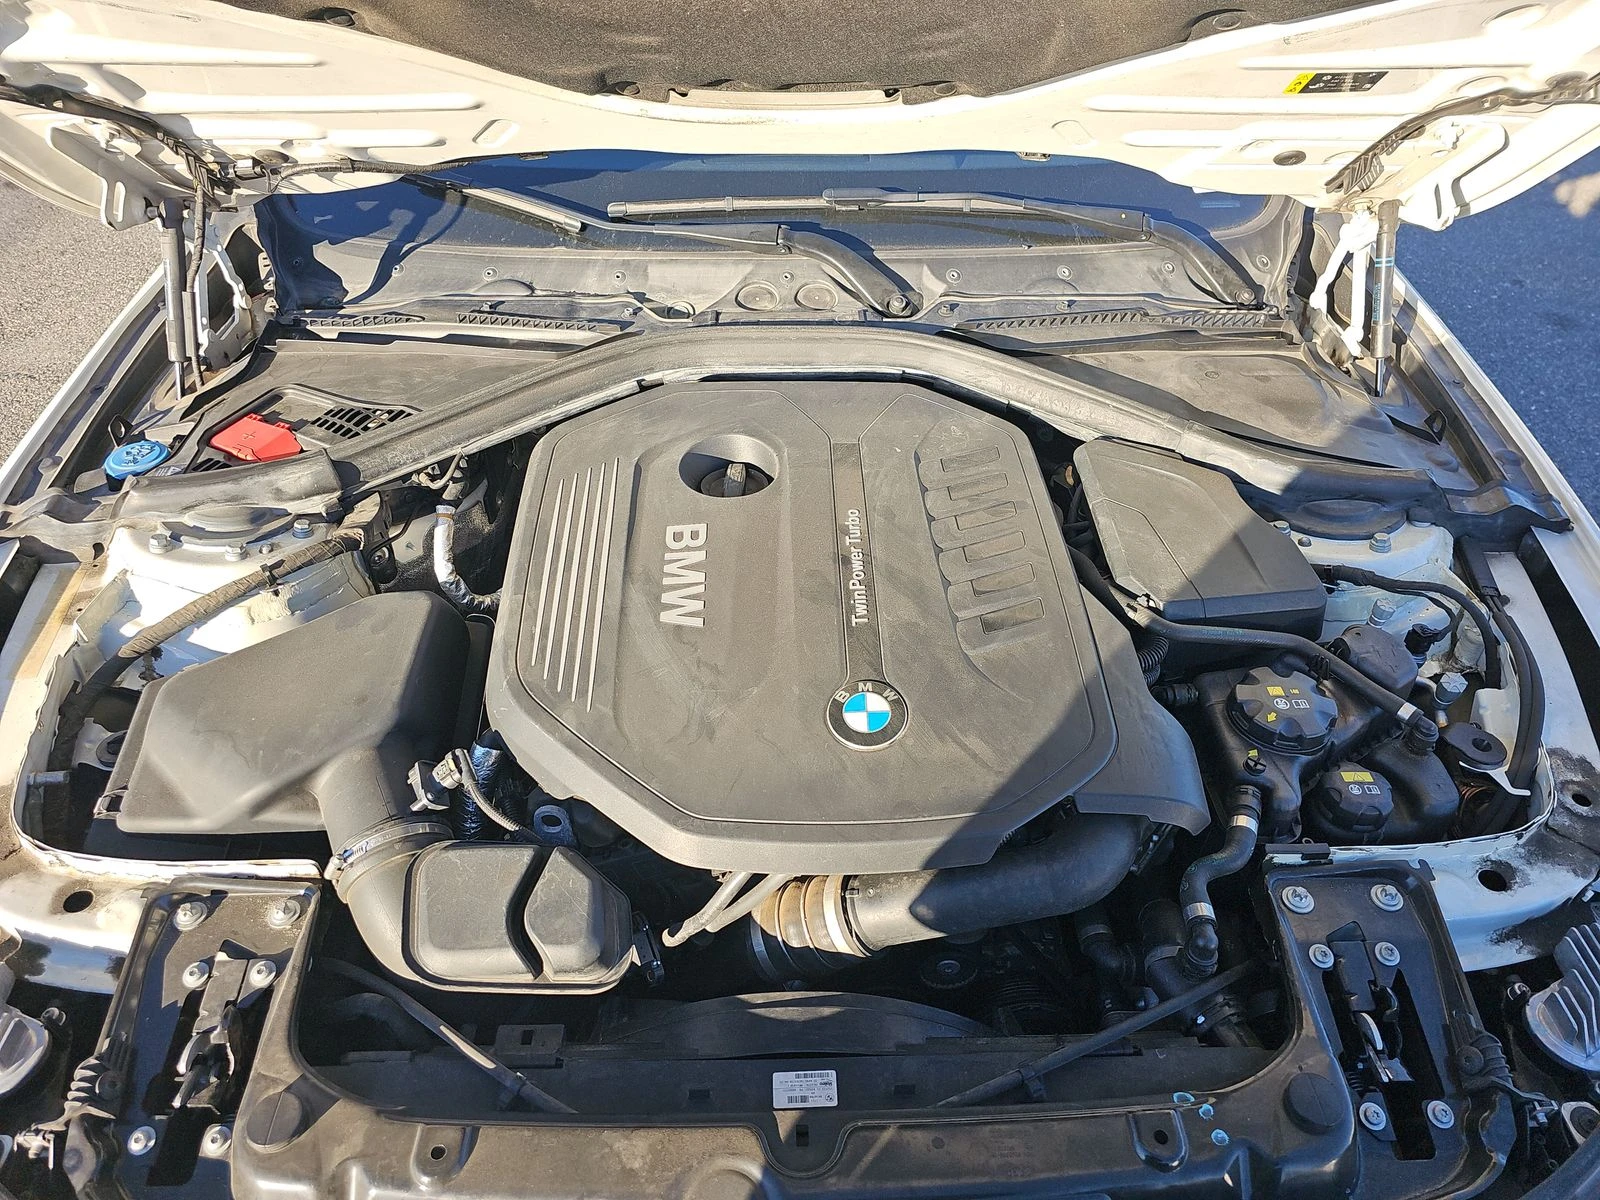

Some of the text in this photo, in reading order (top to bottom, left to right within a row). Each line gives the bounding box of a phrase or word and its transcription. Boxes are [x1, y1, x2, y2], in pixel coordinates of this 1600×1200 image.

[660, 523, 708, 627] BMW
[845, 509, 869, 627] TwinPower Turbo
[835, 682, 899, 704] BMW
